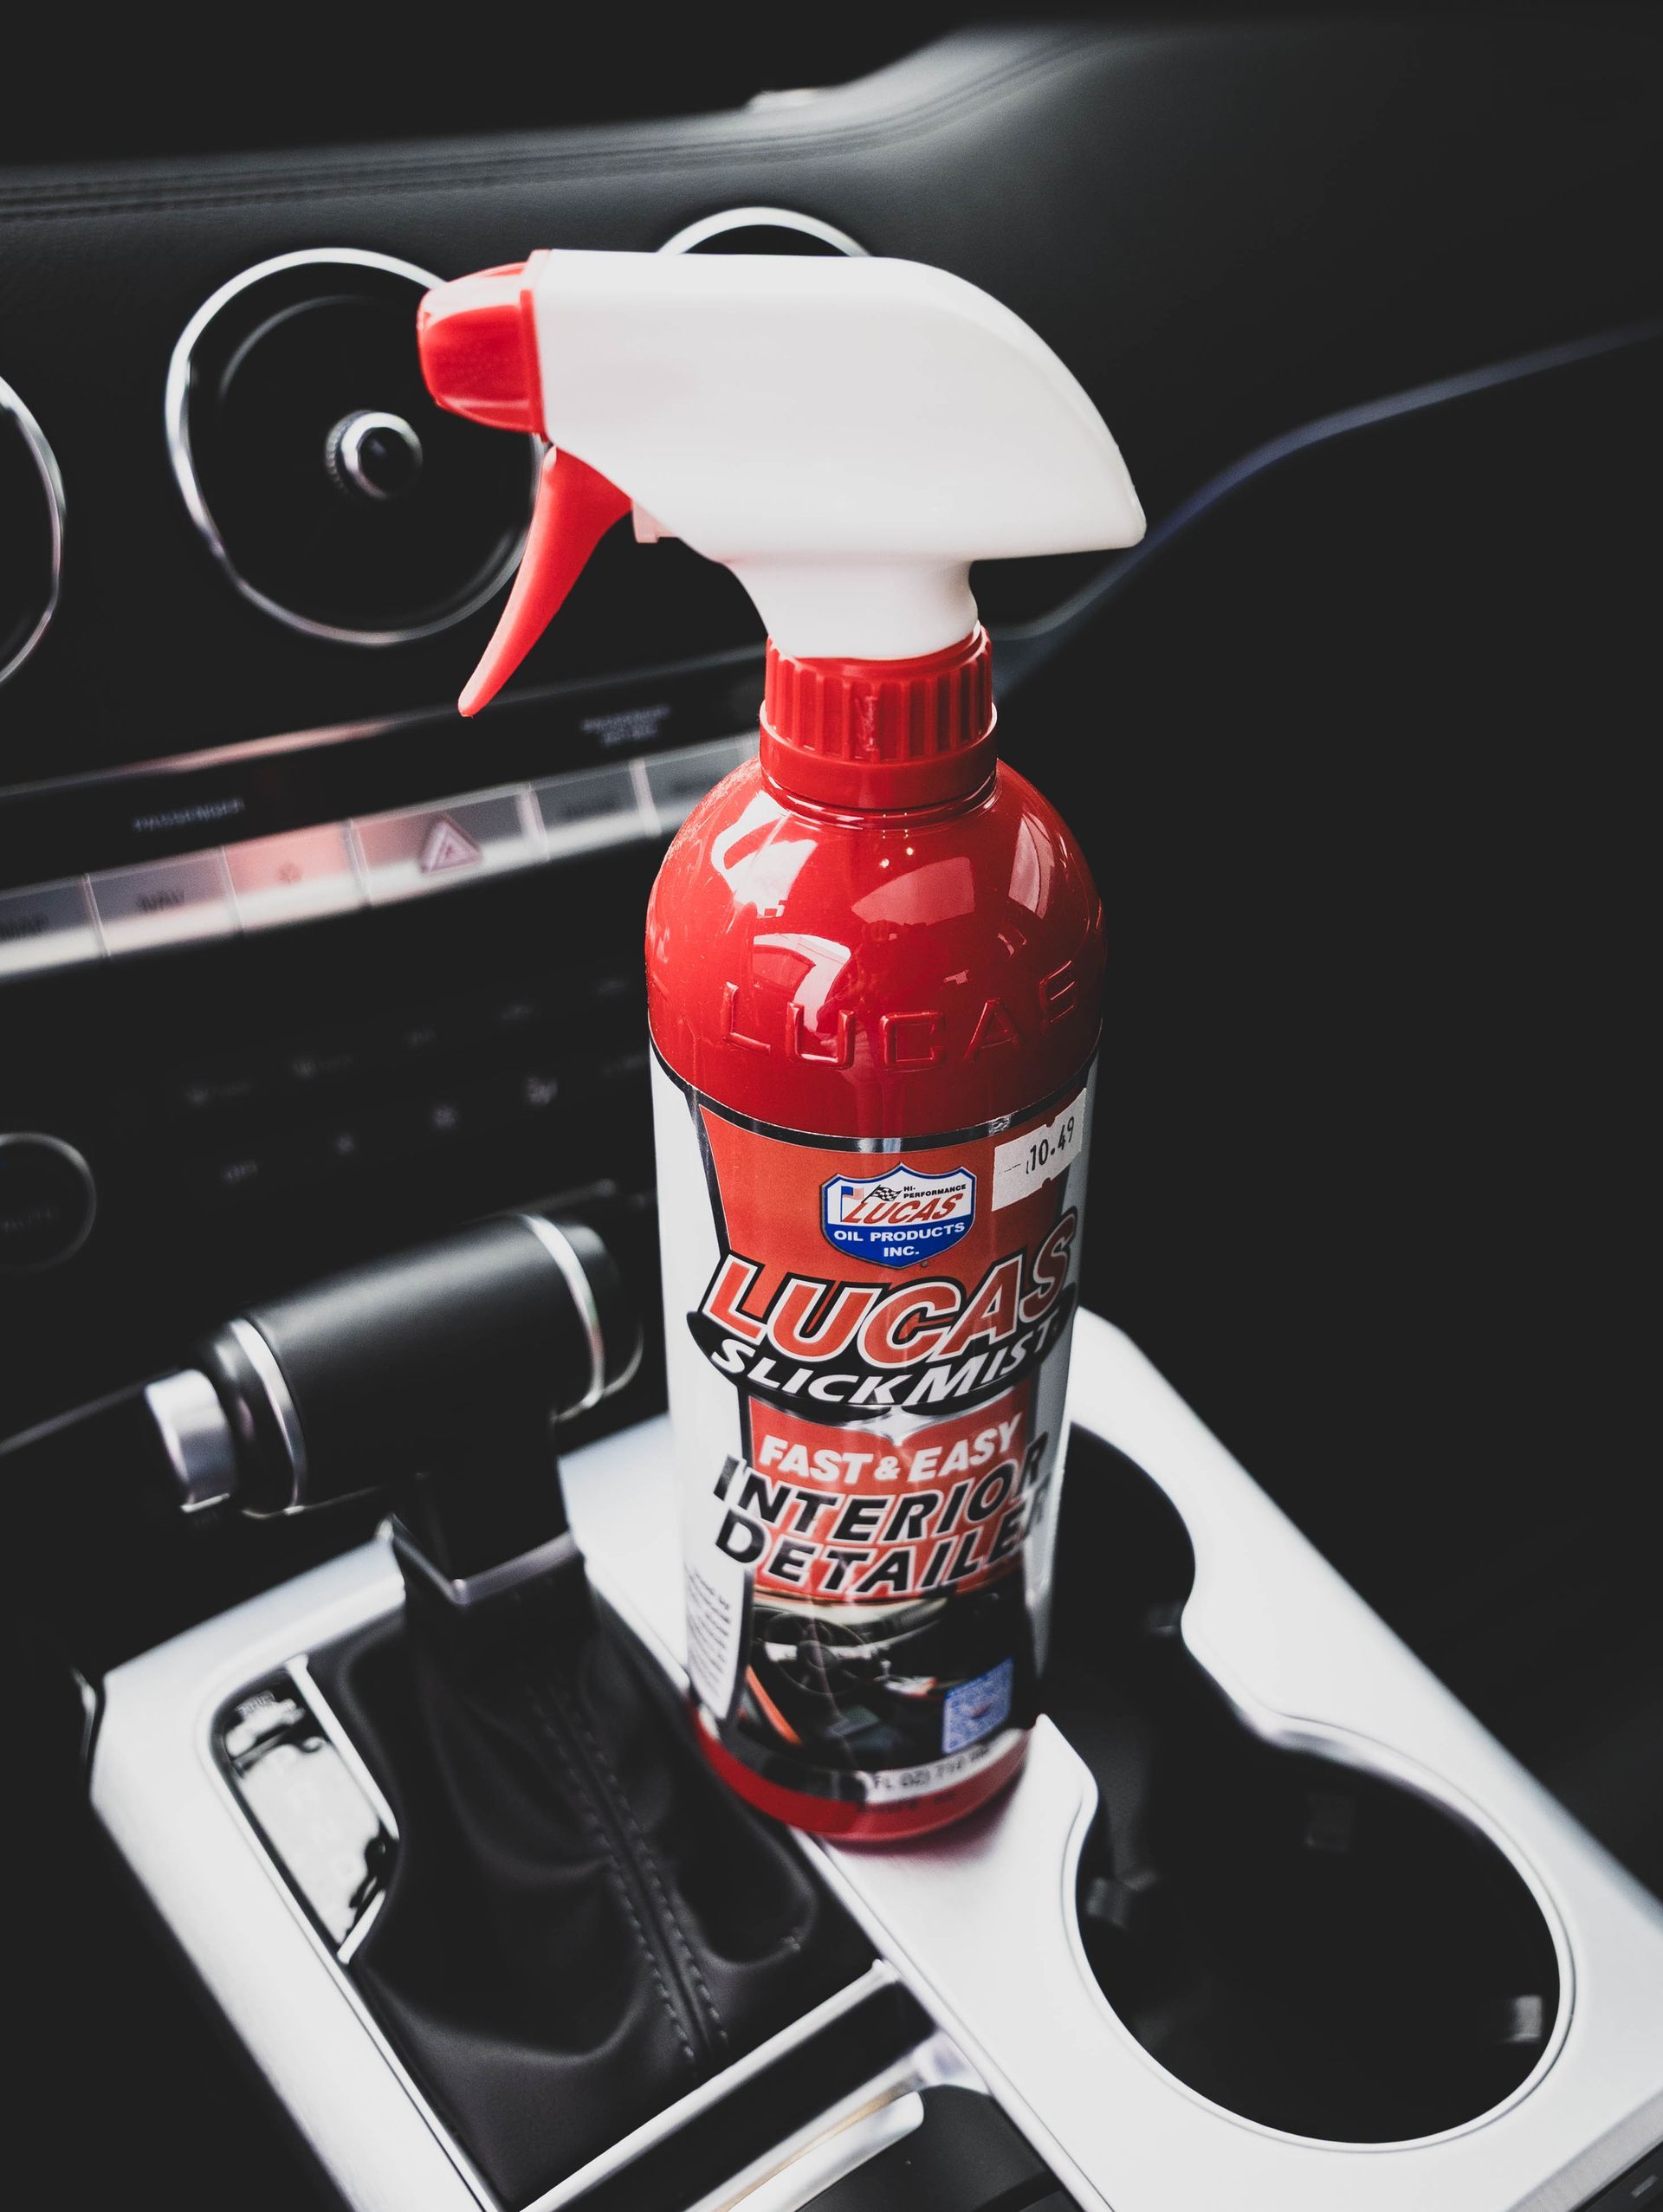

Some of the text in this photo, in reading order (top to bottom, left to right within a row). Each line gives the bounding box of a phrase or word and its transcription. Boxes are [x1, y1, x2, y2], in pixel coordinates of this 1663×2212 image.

[903, 1184, 967, 1199] PERFORMANCE
[842, 1193, 964, 1225] LUCAS
[833, 1222, 966, 1243] OIL PRODUCTS
[883, 1246, 920, 1258] INC.
[700, 1211, 1077, 1370] LUCAS
[758, 1413, 1022, 1484] FAST & EASY
[712, 1431, 1049, 1543] INTERIOR
